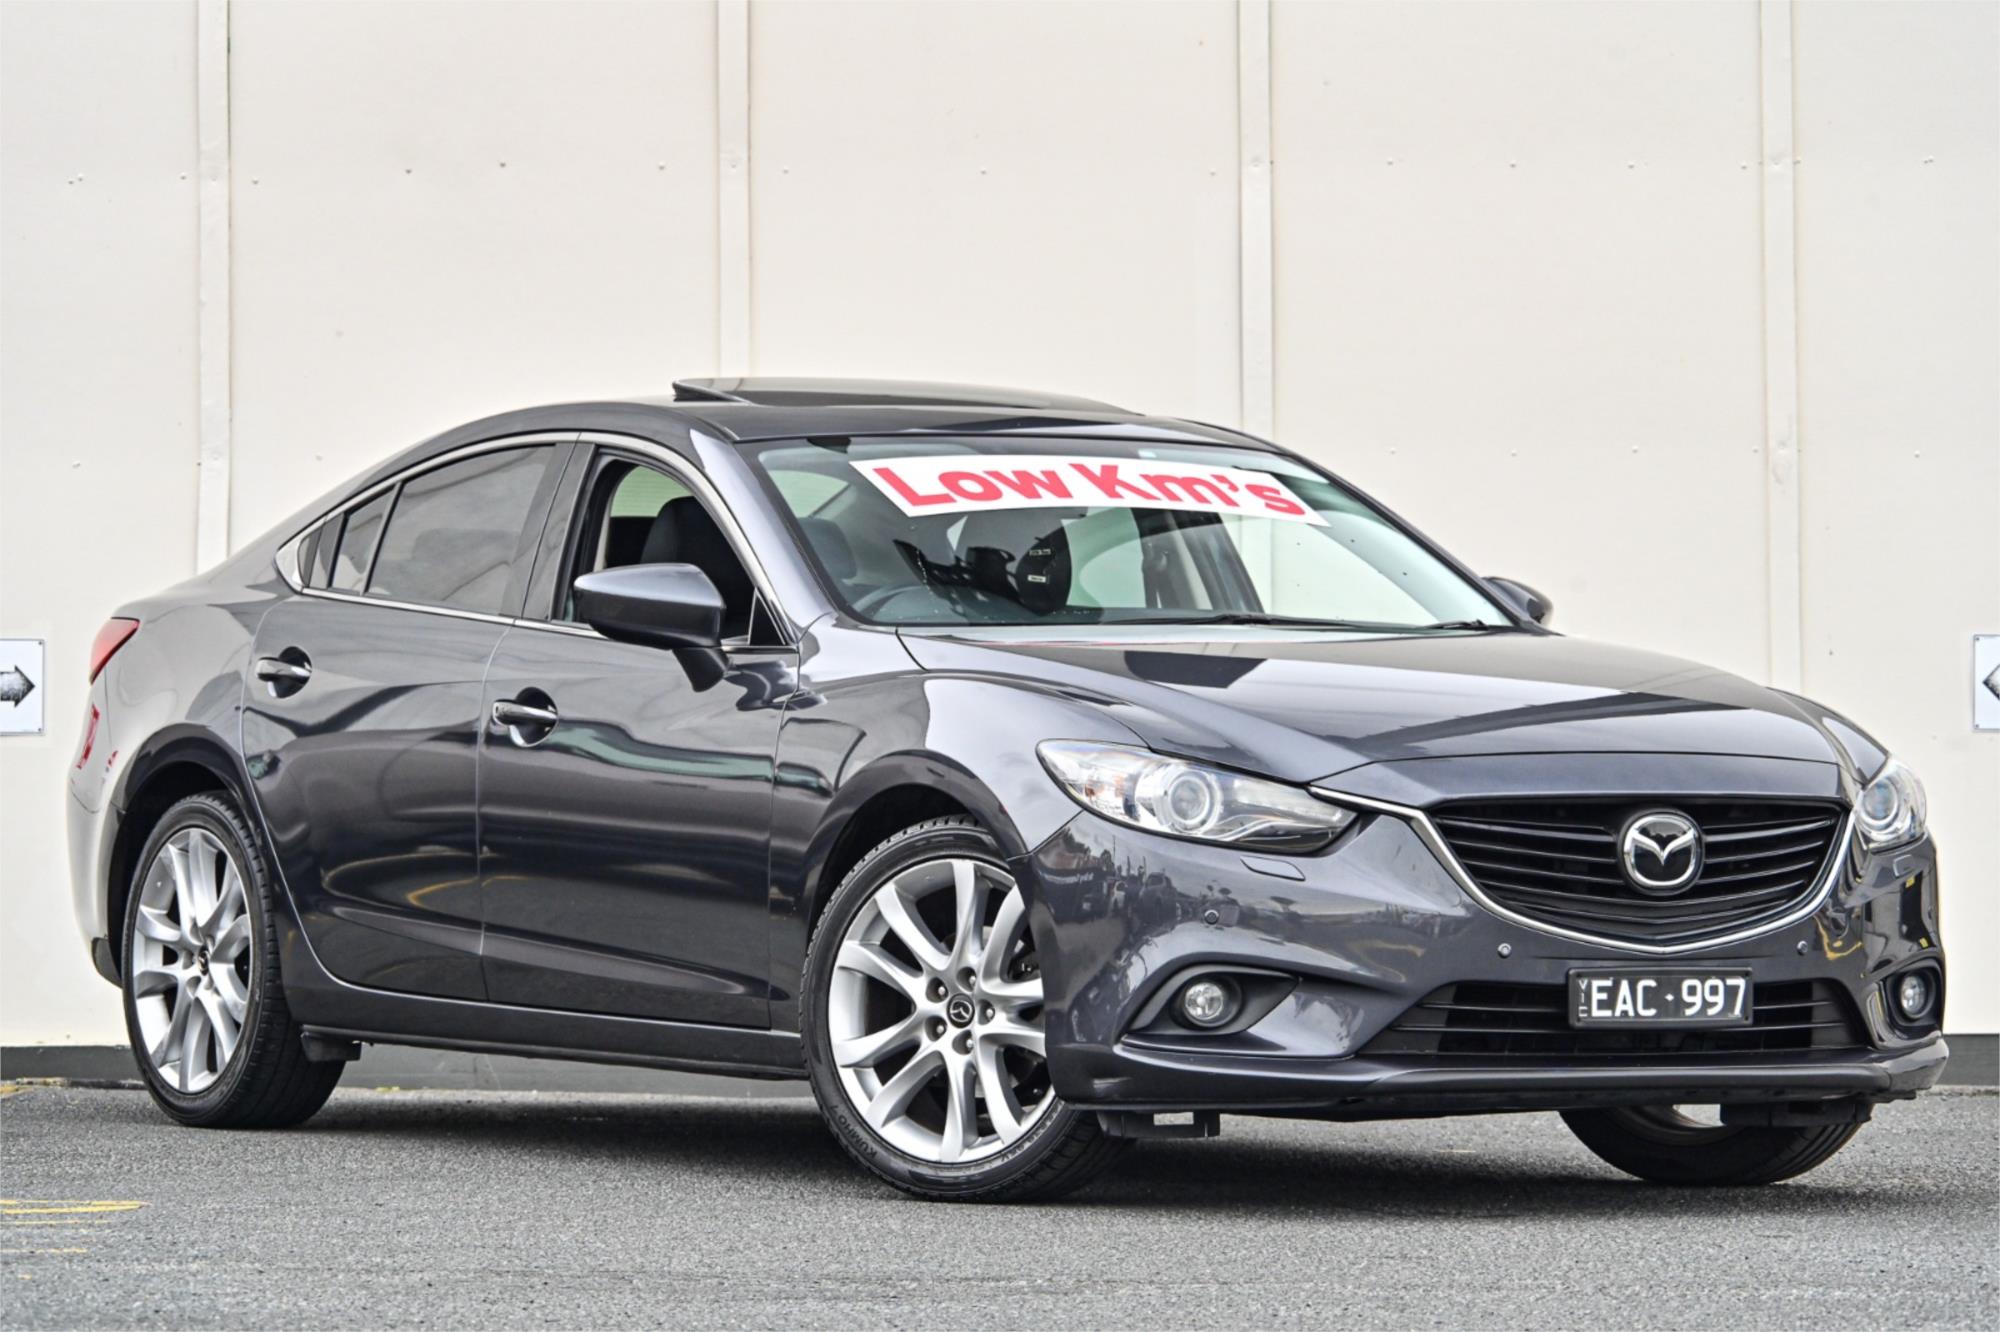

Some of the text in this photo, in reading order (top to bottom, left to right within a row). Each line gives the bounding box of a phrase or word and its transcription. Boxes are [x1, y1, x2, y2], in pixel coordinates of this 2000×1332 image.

[873, 463, 1306, 516] Low Km's
[1578, 979, 1588, 1017] VIC
[838, 1114, 878, 1159] KUMHO
